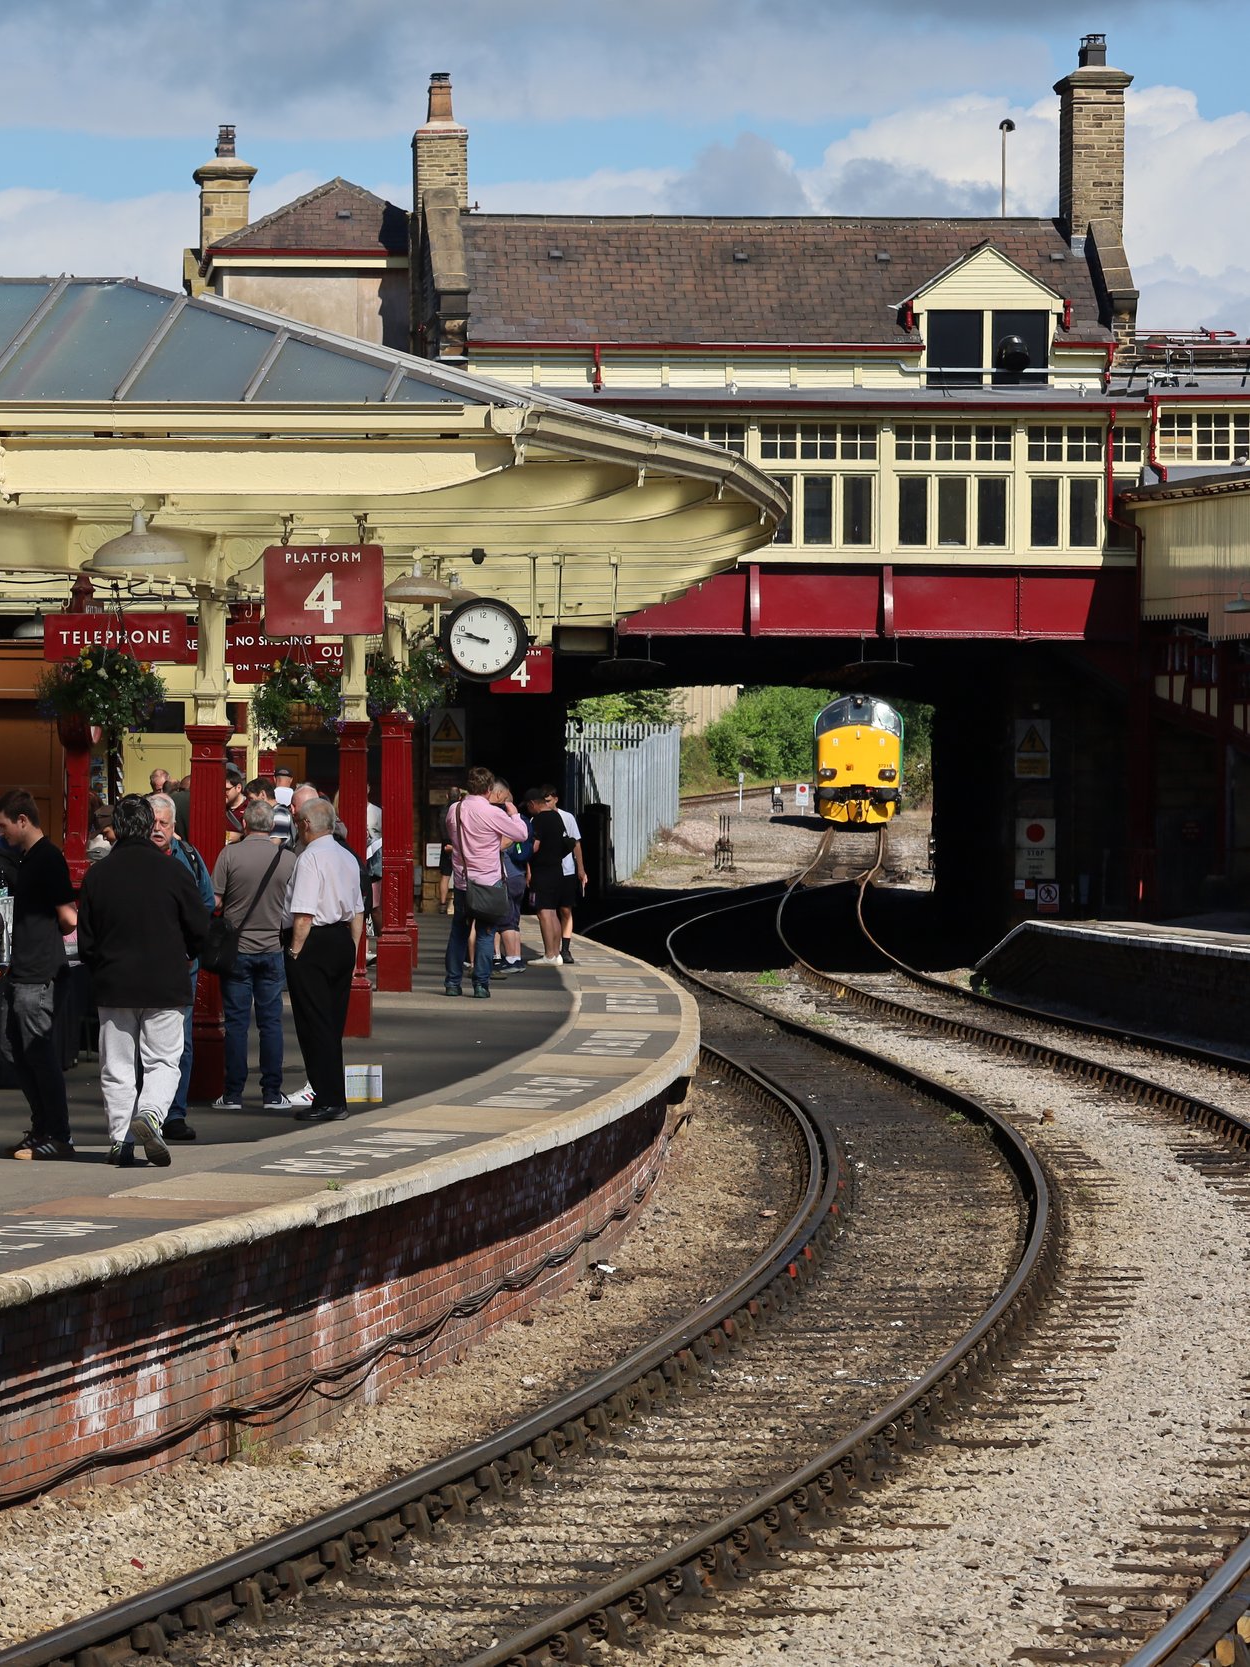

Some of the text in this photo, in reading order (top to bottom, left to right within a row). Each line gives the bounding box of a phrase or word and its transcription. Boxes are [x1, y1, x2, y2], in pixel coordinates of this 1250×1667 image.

[285, 552, 361, 563] PLATFORM
[303, 572, 342, 624] 4
[480, 611, 487, 619] 12
[59, 629, 171, 645] TELEPHONE
[236, 636, 254, 646] NO
[507, 636, 513, 644] 3
[510, 660, 530, 688] 4
